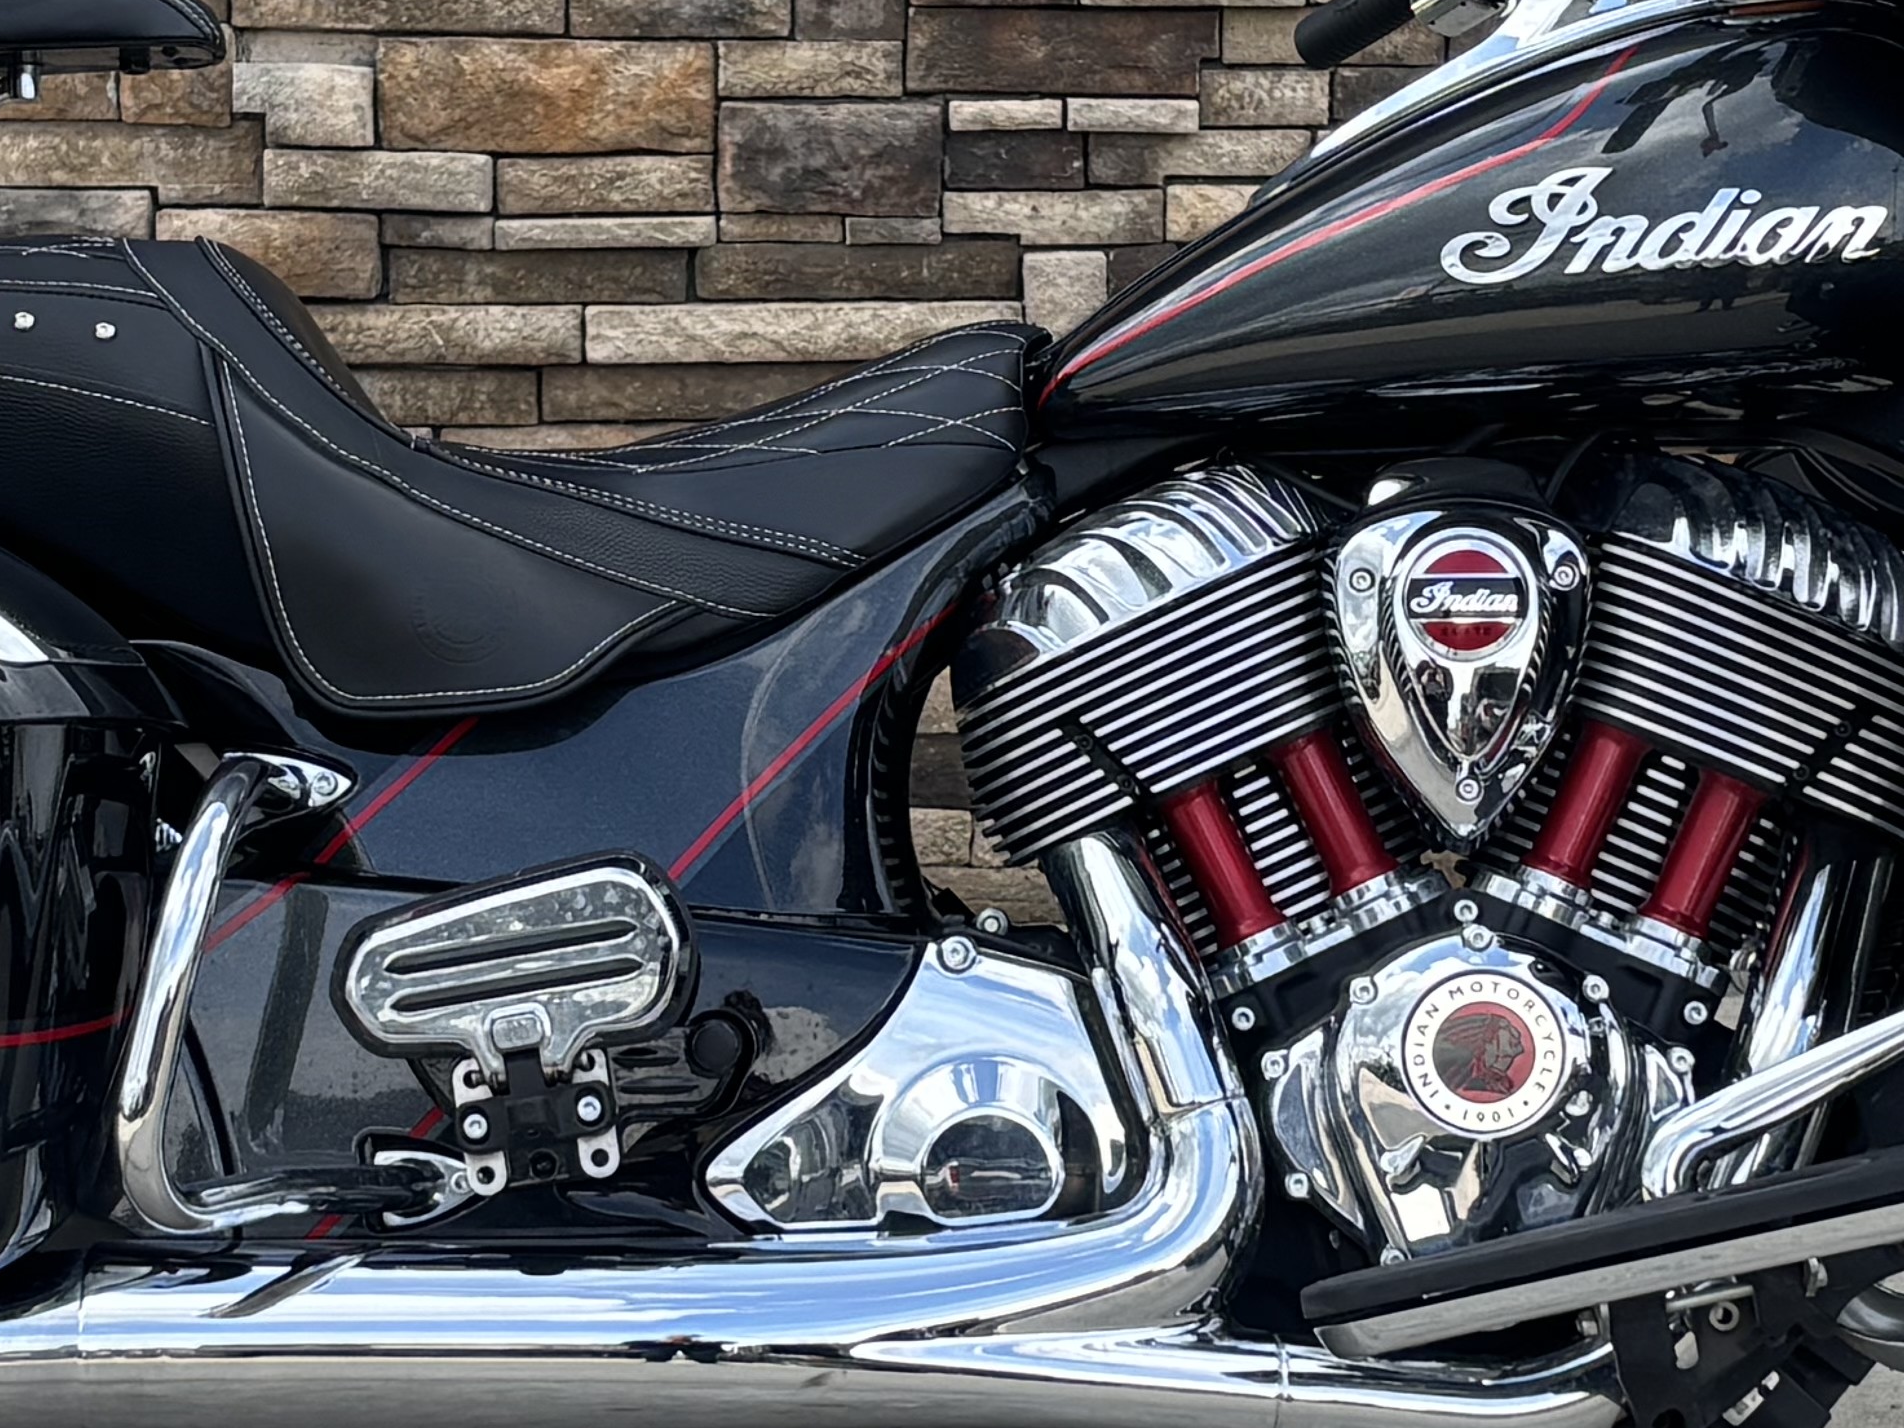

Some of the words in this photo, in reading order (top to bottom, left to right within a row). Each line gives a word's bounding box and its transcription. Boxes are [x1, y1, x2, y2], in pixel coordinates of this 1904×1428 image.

[1440, 167, 1888, 284] Indian
[1409, 581, 1519, 614] Indian
[1413, 1003, 1440, 1100] INDIAN
[1449, 981, 1556, 1094] MOTORCYCLE
[1462, 1107, 1515, 1123] 1901
